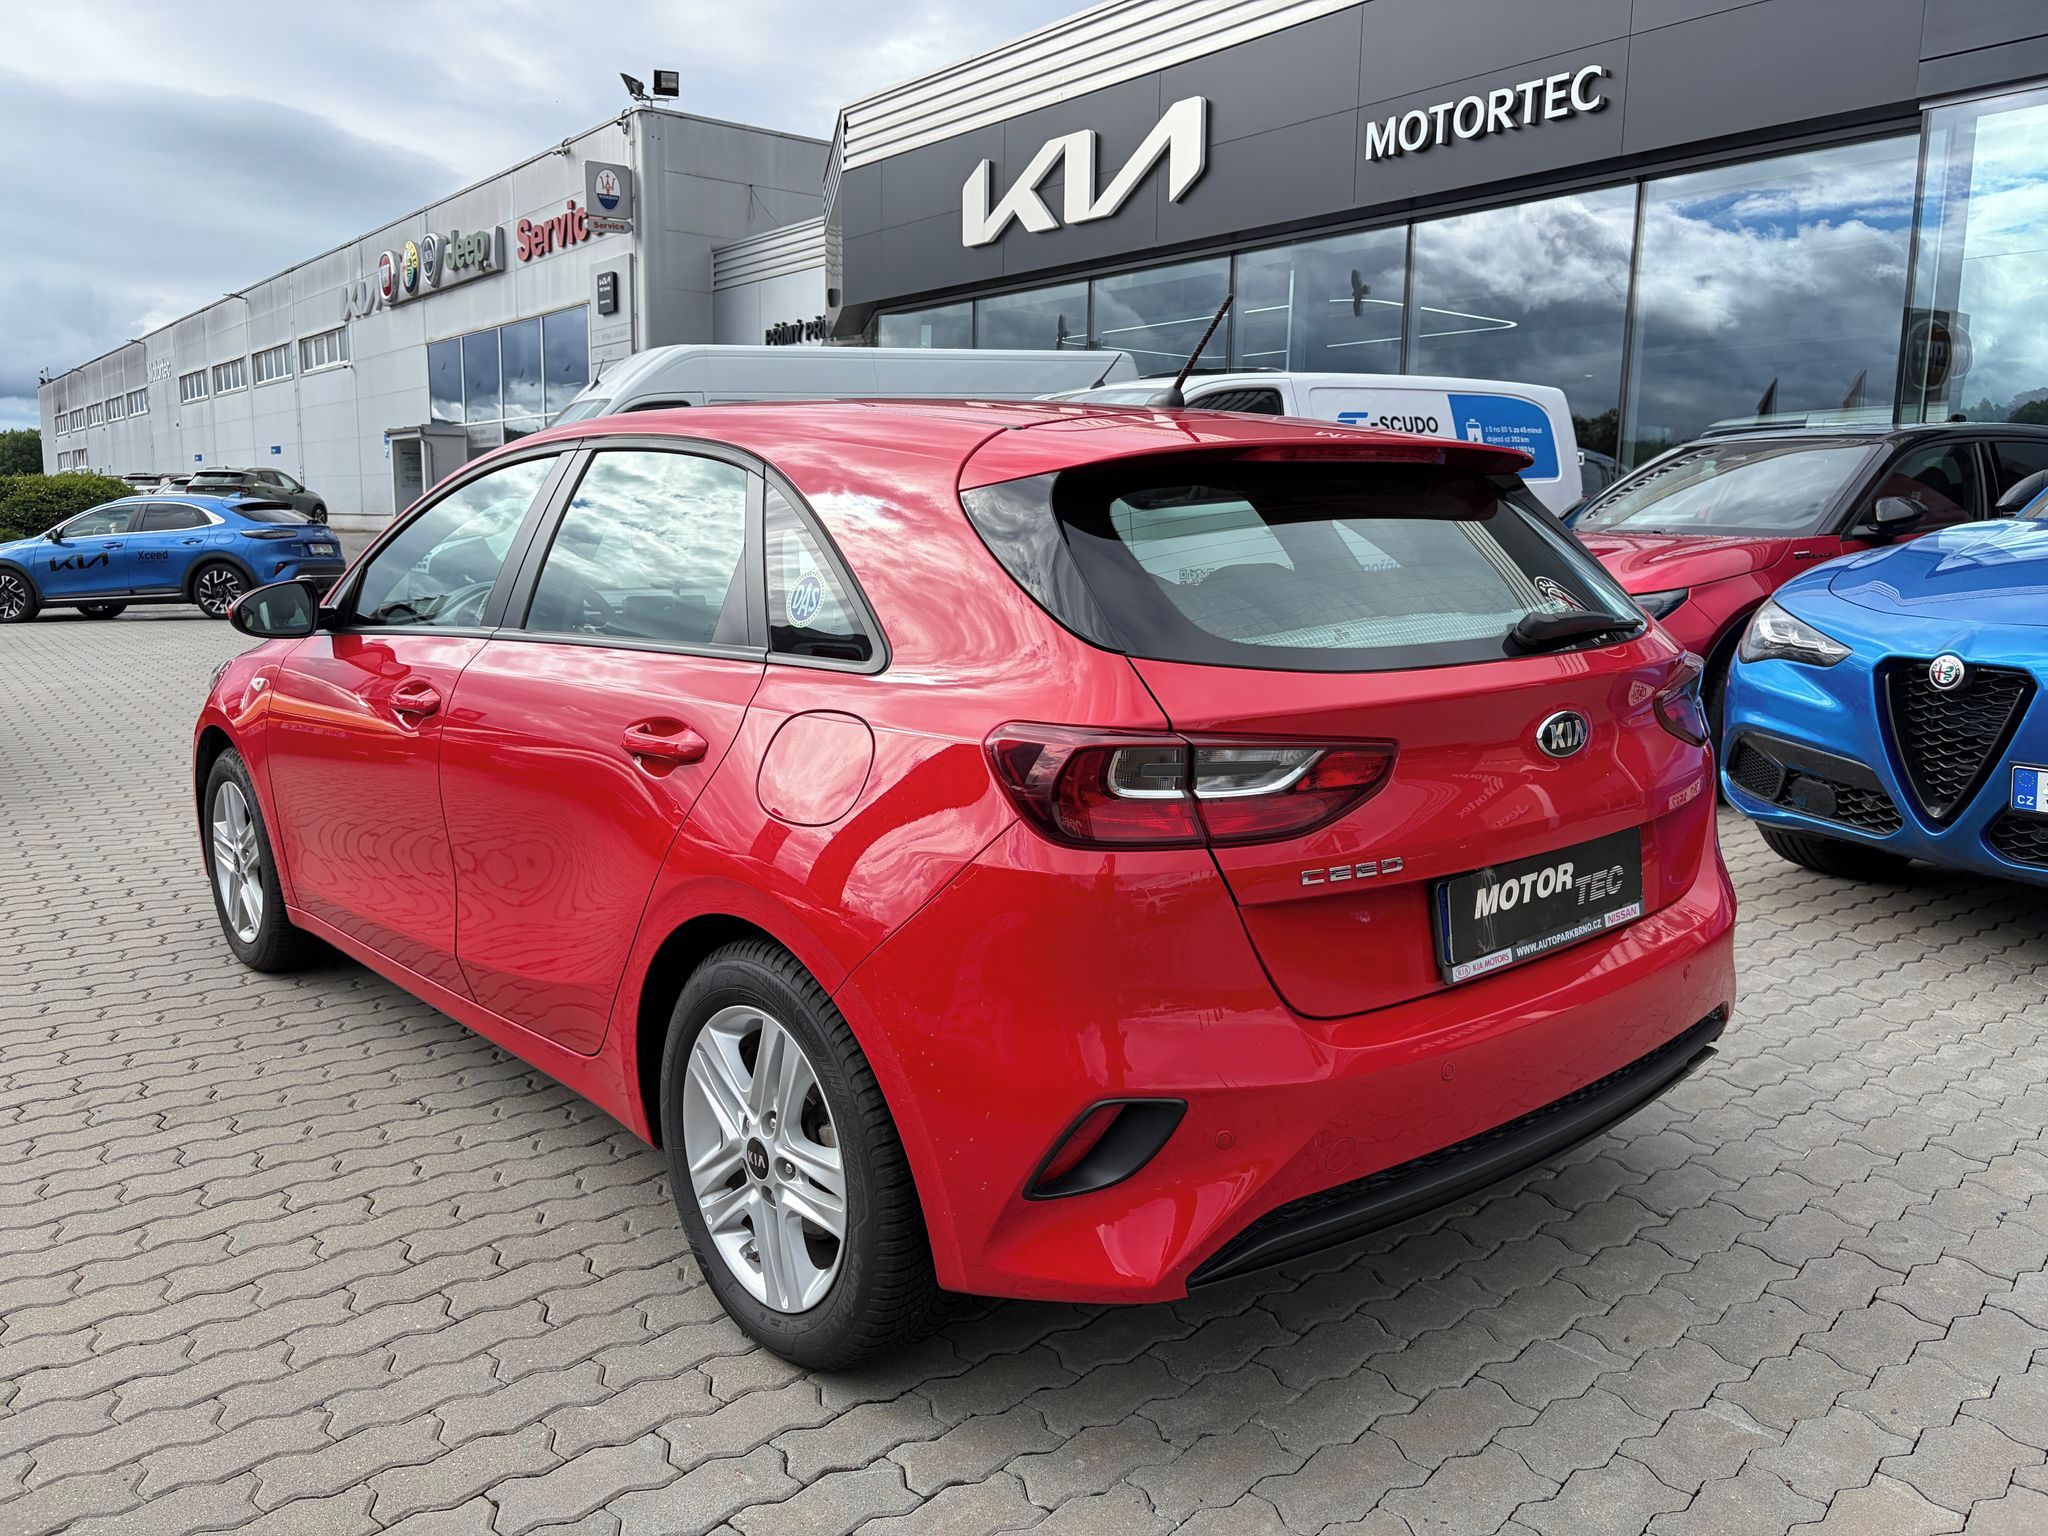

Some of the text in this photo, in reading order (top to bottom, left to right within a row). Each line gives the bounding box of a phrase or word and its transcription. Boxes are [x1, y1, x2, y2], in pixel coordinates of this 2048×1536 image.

[1365, 64, 1608, 161] MOTORTEC
[962, 95, 1207, 248] KIA
[516, 199, 606, 263] Servic
[593, 221, 626, 231] Service
[445, 229, 490, 273] Jeep
[765, 318, 804, 346] PŘÍMÝ
[49, 552, 110, 572] KIA
[137, 550, 169, 561] Xceed
[792, 582, 820, 617] DAS
[1549, 719, 1584, 750] KIA
[2017, 794, 2034, 806] CZ
[1301, 856, 1404, 886] CEED
[1472, 962, 1484, 972] KIA
[1484, 952, 1510, 967] MOTORS
[1516, 918, 1603, 957] WWW.AUTOPARKBRNO.CZ
[1607, 905, 1637, 924] NISSAN
[747, 1150, 766, 1169] KIA
